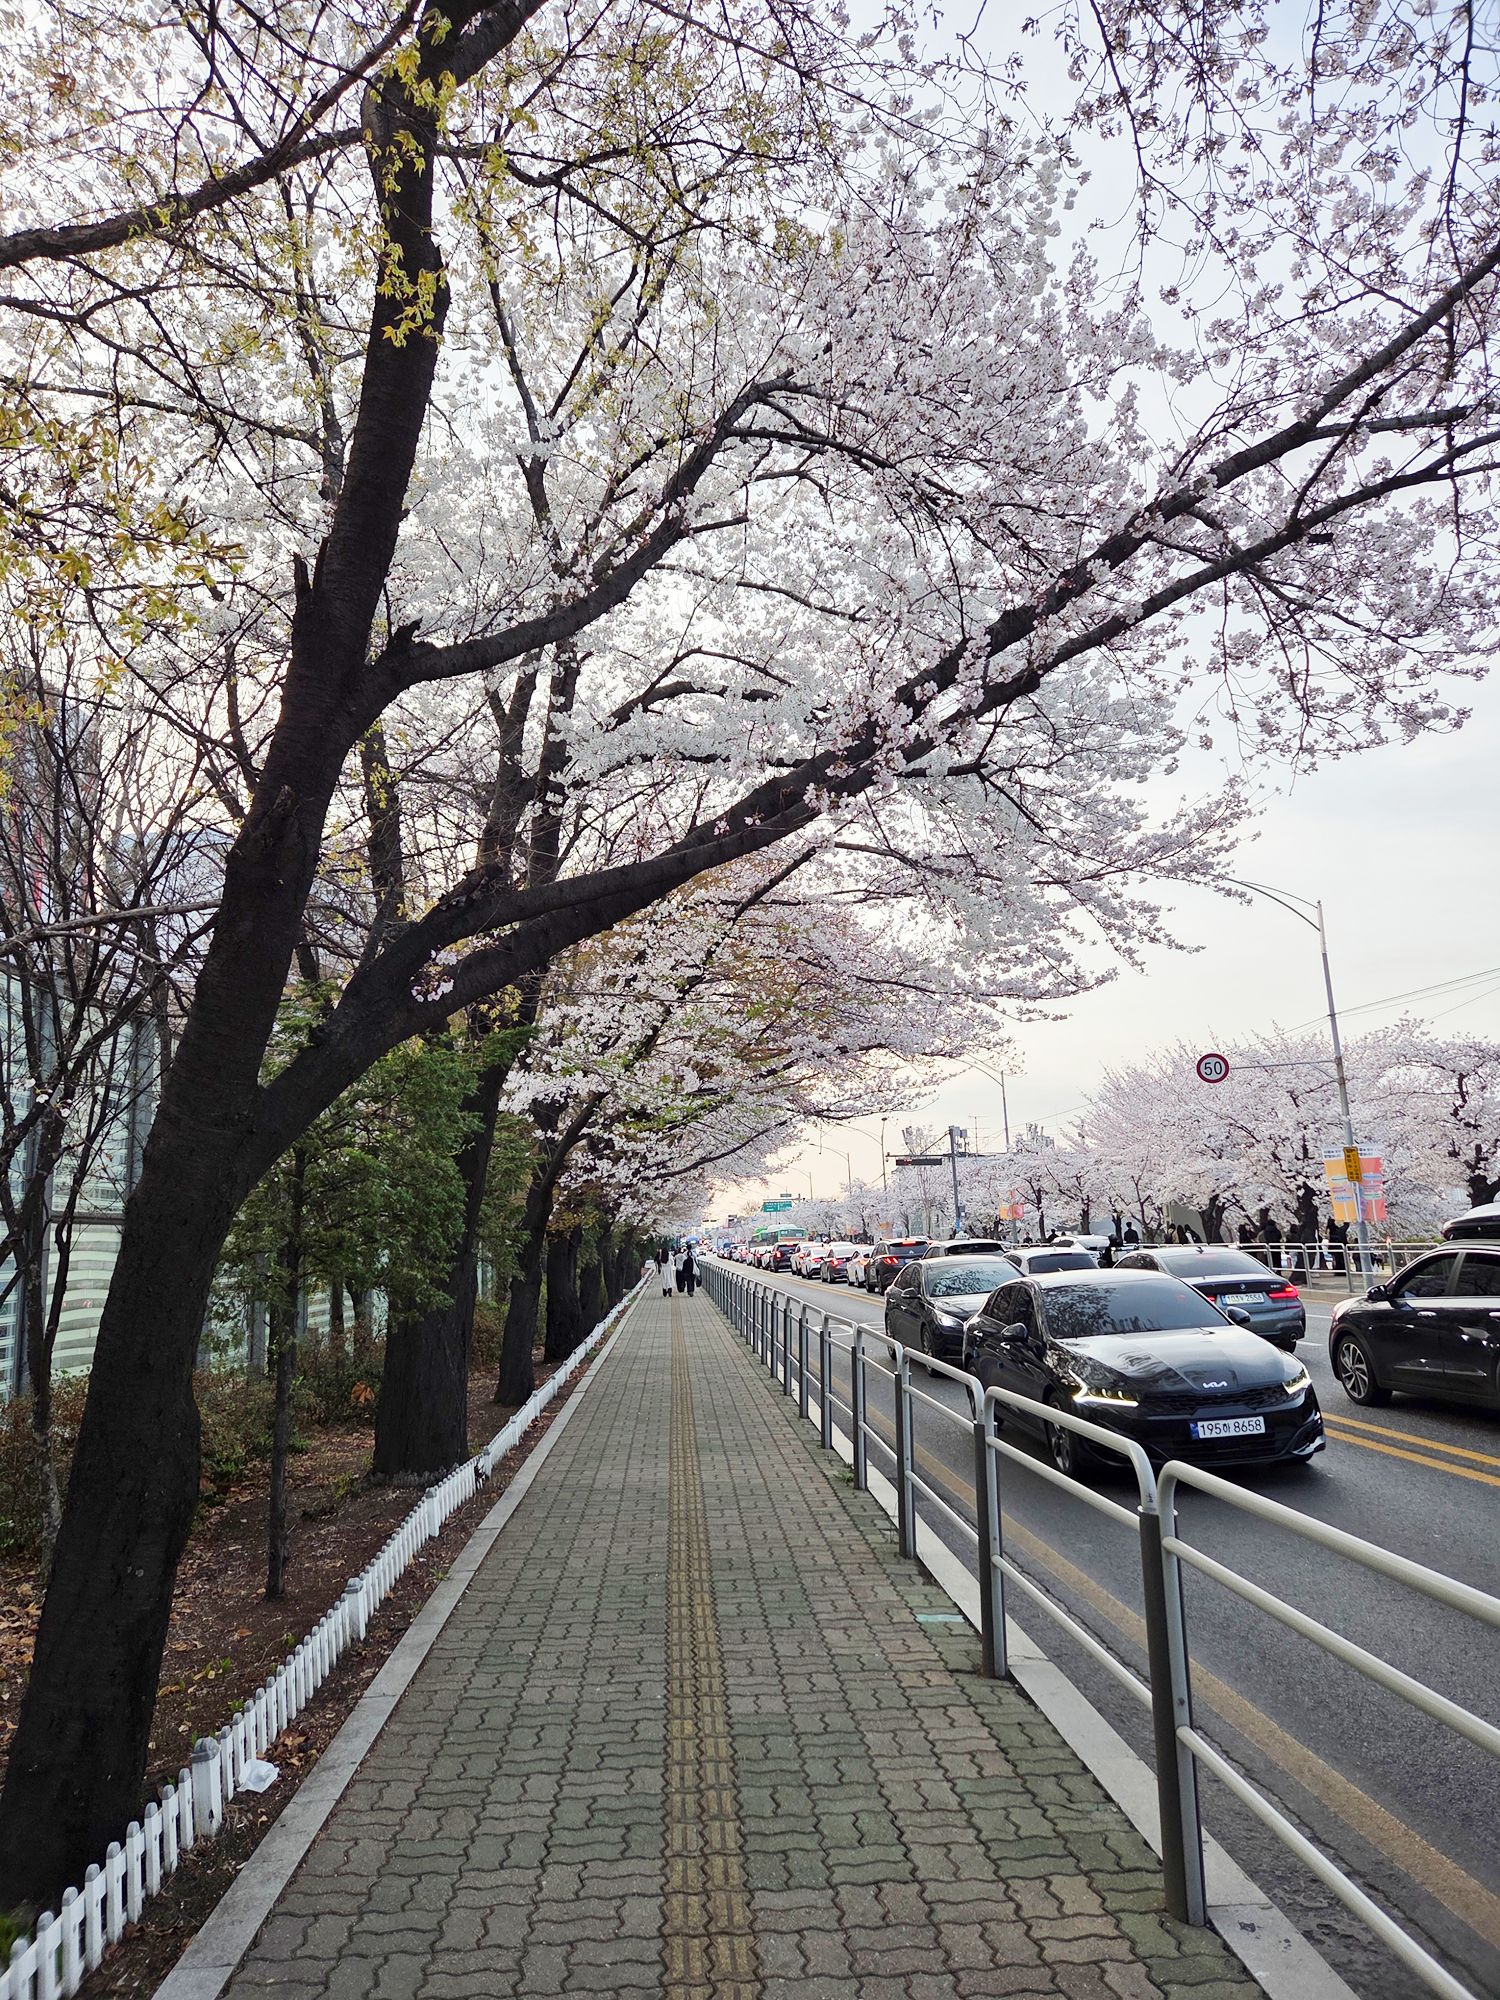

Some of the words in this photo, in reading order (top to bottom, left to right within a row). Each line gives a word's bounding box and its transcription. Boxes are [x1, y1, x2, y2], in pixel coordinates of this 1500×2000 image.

[1204, 1061, 1223, 1076] 50
[1200, 1423, 1231, 1436] 195하
[1233, 1419, 1262, 1433] 8658
